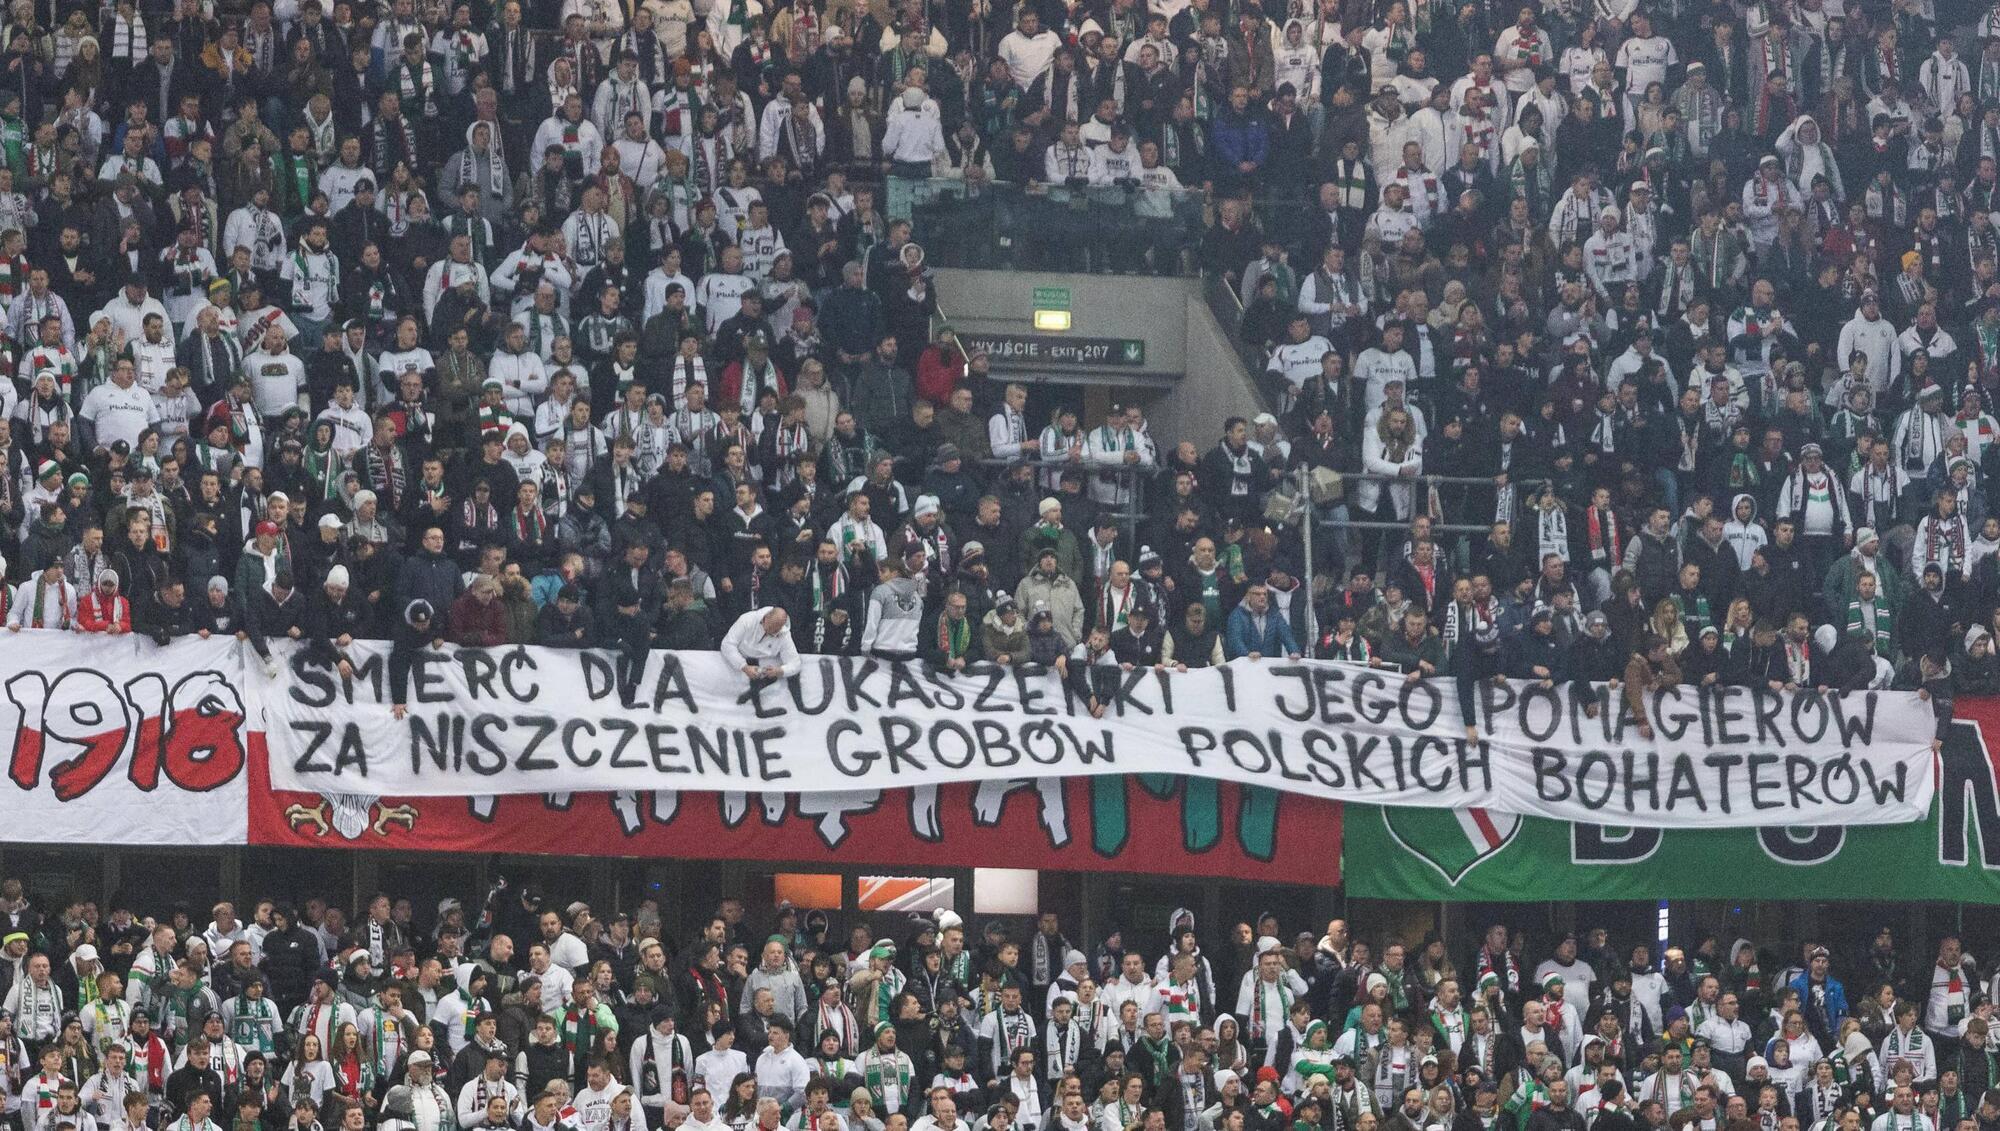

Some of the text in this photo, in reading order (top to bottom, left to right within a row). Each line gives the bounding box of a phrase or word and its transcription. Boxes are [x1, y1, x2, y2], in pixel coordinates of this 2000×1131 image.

[971, 339, 1039, 357] WYJŚCIE
[1051, 346, 1077, 358] EXIT
[1084, 344, 1110, 358] 207
[5, 667, 246, 802] 1918
[580, 651, 699, 714] DLA
[1216, 664, 1237, 713] I
[1268, 665, 1442, 731] JEGO
[289, 721, 368, 777] ZA
[409, 711, 792, 781] NISZCZENIE
[826, 716, 1115, 777] GROBÓW
[1178, 726, 1492, 792] POLSKICH
[1530, 747, 1908, 814] BOHATERÓW
